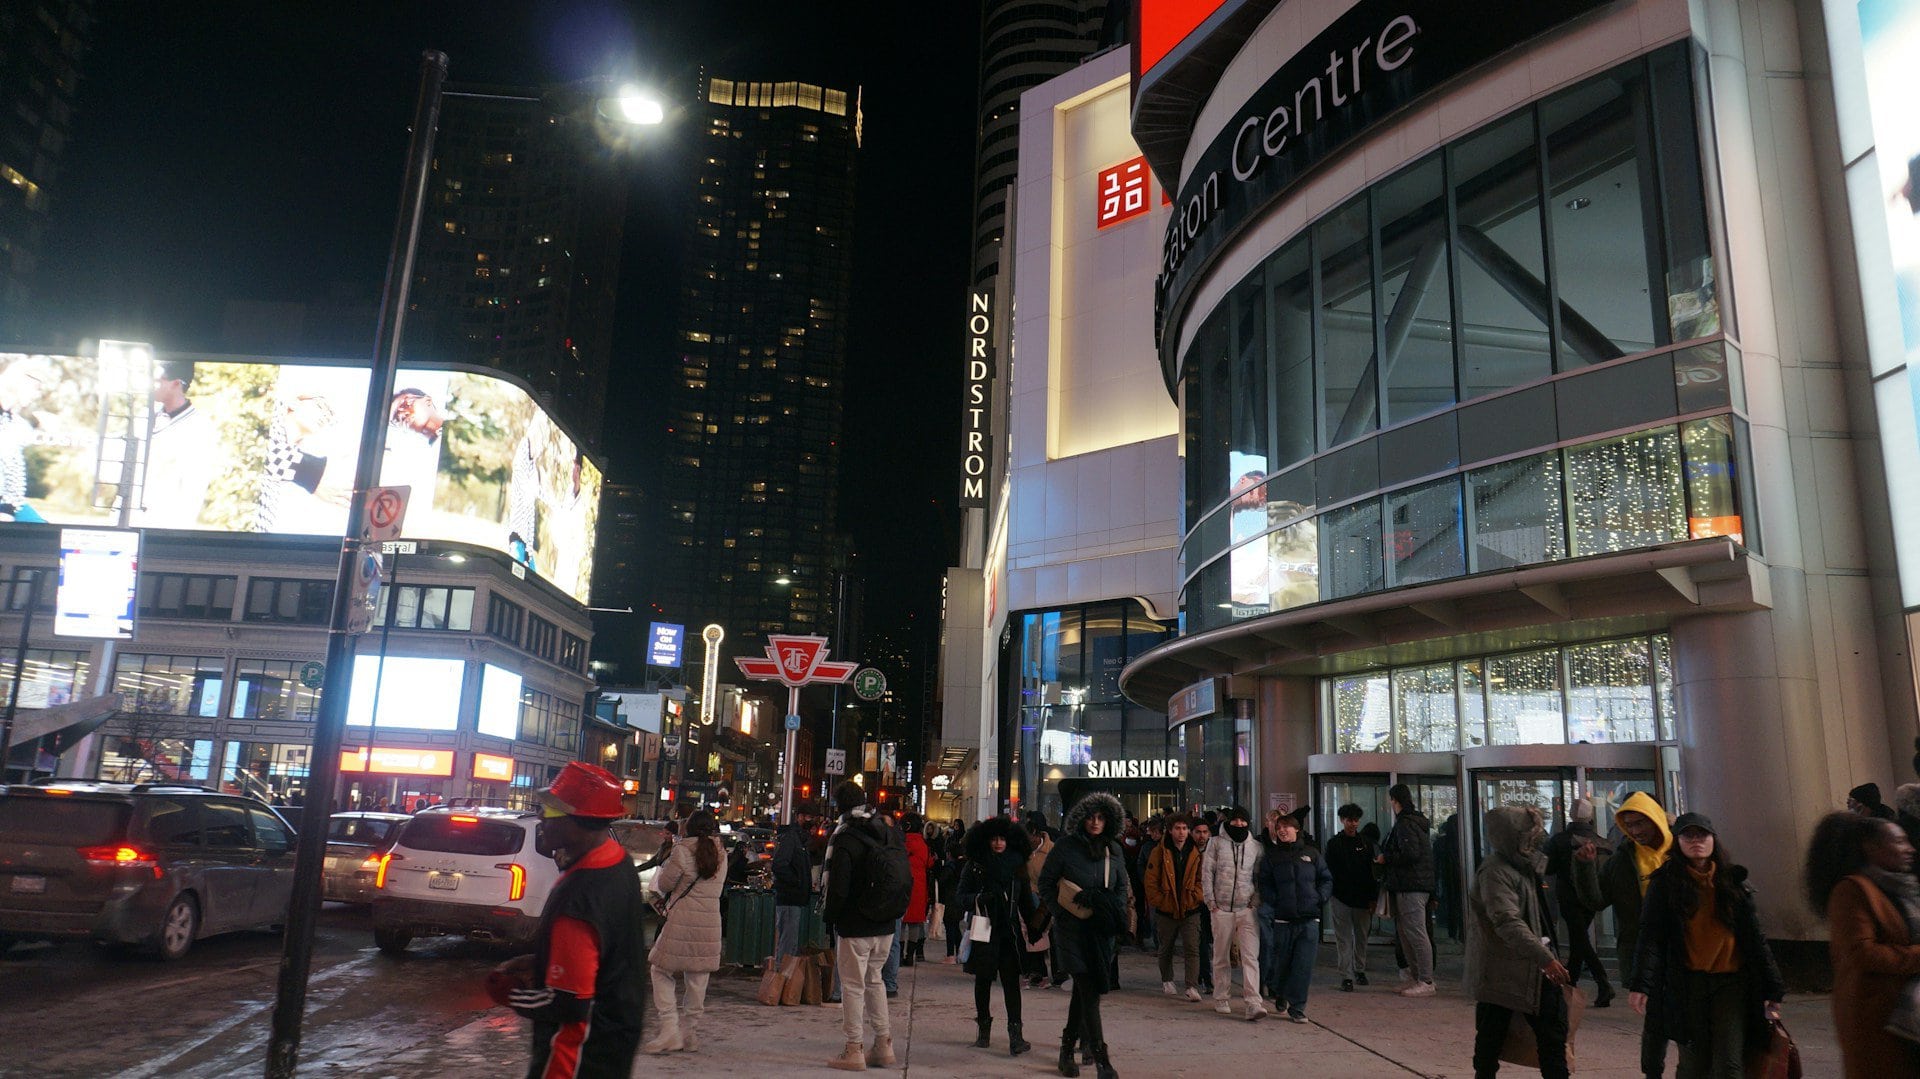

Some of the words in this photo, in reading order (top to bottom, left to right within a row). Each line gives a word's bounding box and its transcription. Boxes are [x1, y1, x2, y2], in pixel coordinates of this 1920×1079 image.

[1232, 15, 1417, 182] Centre
[964, 293, 989, 499] NORDSTROM
[864, 676, 877, 690] P
[827, 759, 844, 771] 40
[1087, 759, 1179, 778] SAMSUNG
